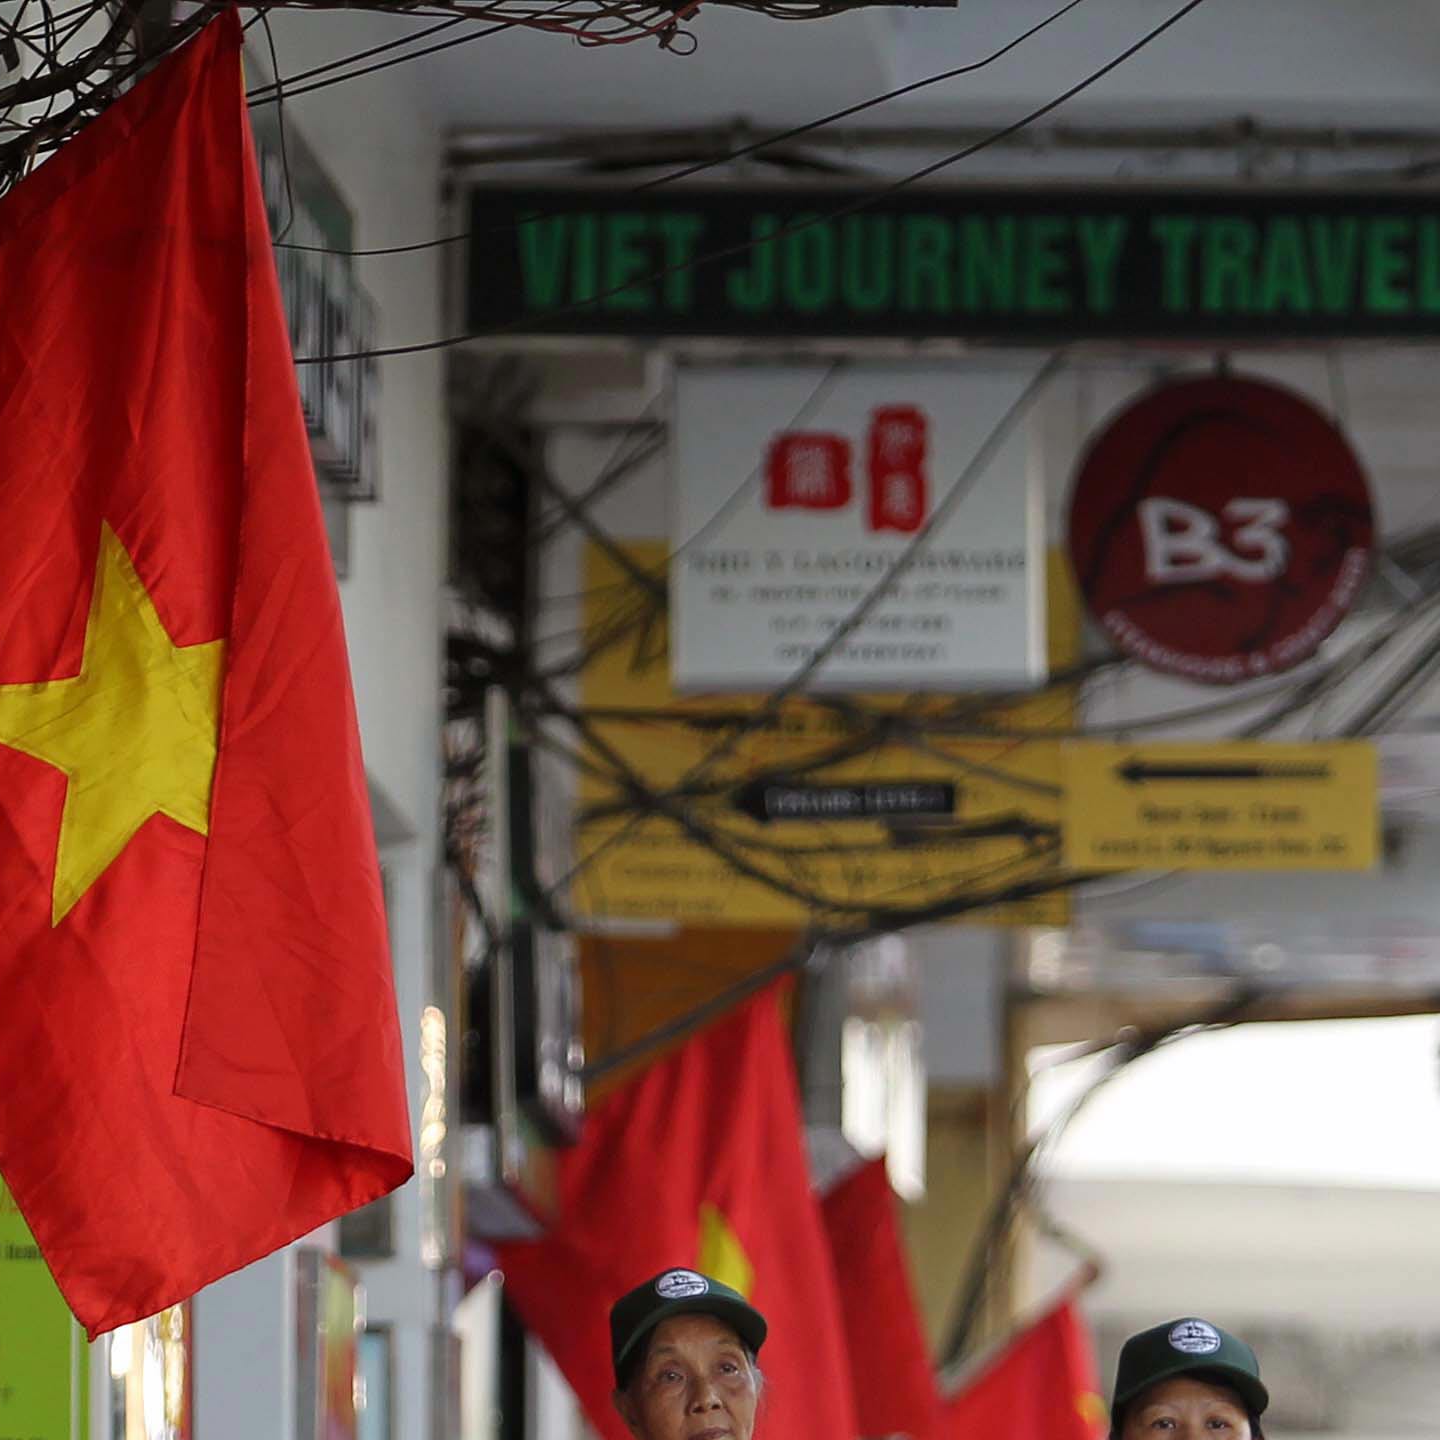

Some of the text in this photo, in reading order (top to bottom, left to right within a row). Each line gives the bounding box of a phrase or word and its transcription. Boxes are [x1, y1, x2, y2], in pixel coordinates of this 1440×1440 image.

[517, 212, 704, 311] VIET
[725, 212, 1126, 312] JOURNEY
[1138, 496, 1291, 586] B3
